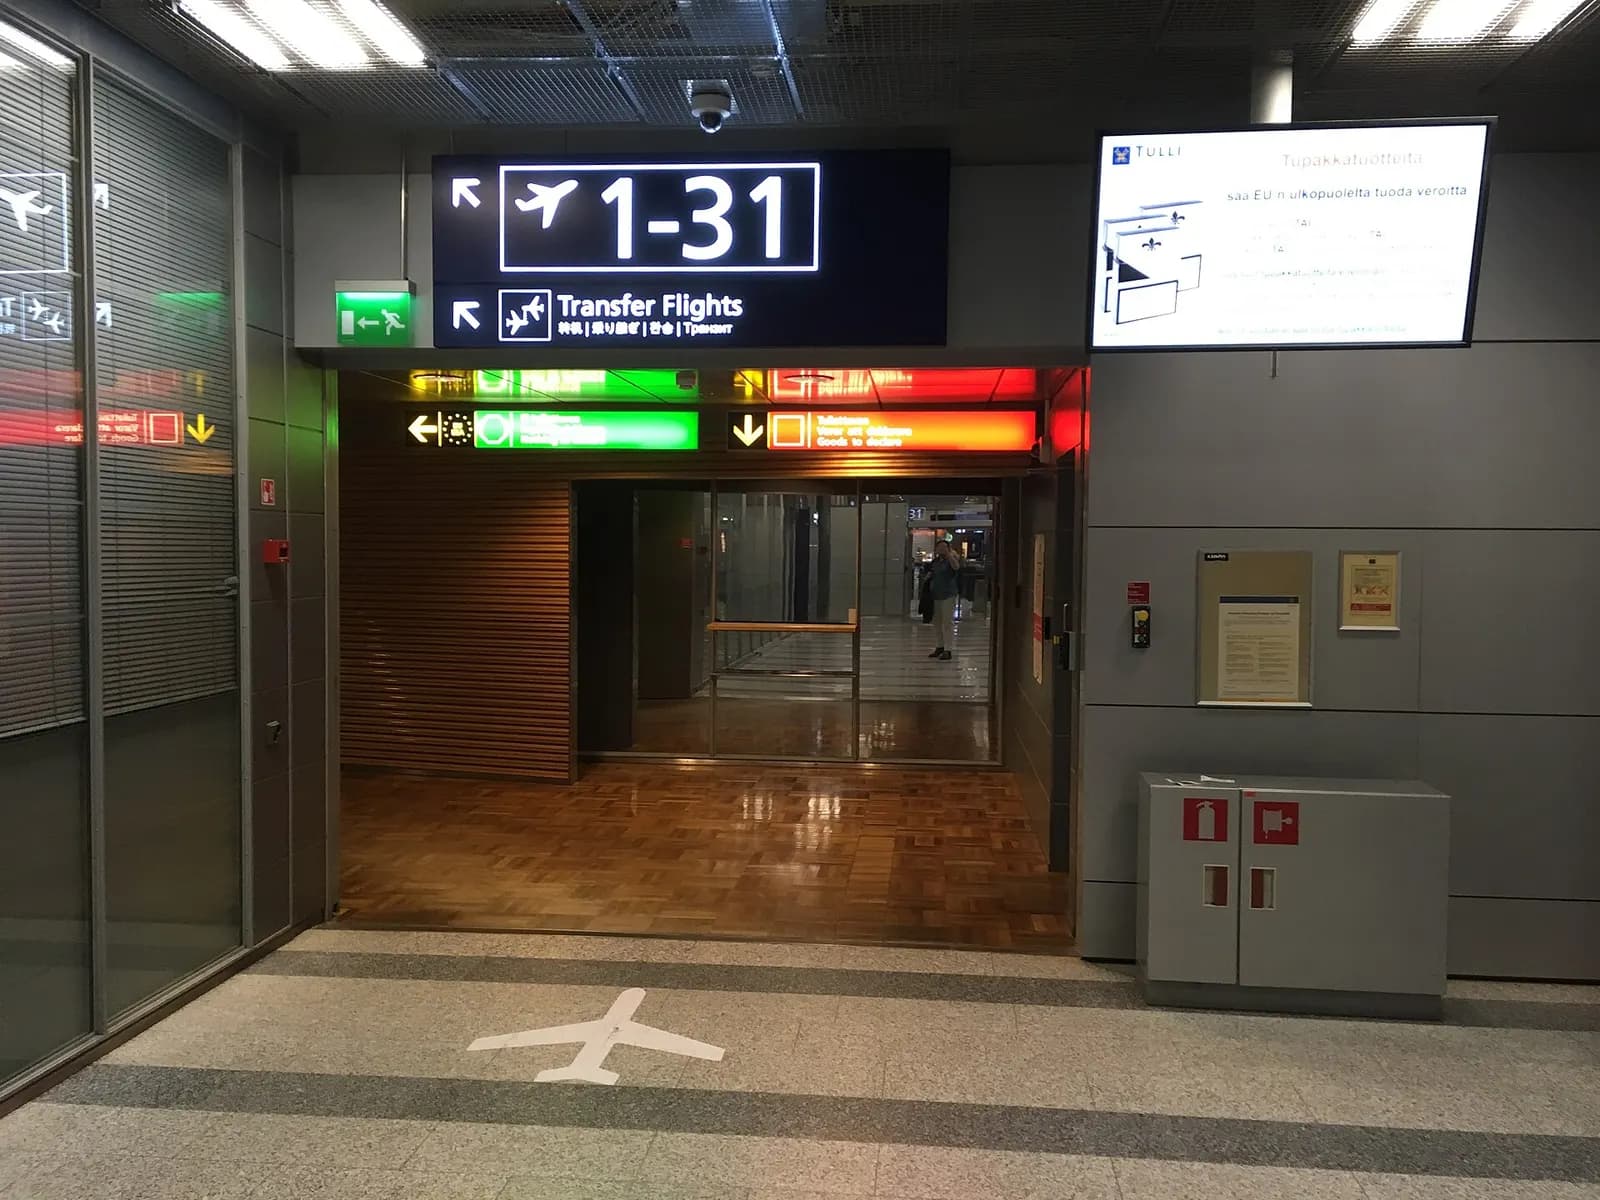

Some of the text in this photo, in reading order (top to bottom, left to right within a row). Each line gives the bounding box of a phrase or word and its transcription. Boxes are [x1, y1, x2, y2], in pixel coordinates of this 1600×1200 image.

[1136, 145, 1181, 158] TULLI
[1227, 192, 1249, 202] saa
[1375, 187, 1413, 199] tuoda
[601, 175, 783, 261] 1-31
[557, 292, 744, 322] Transfer Flights
[816, 436, 849, 448] Goods
[851, 437, 864, 448] to
